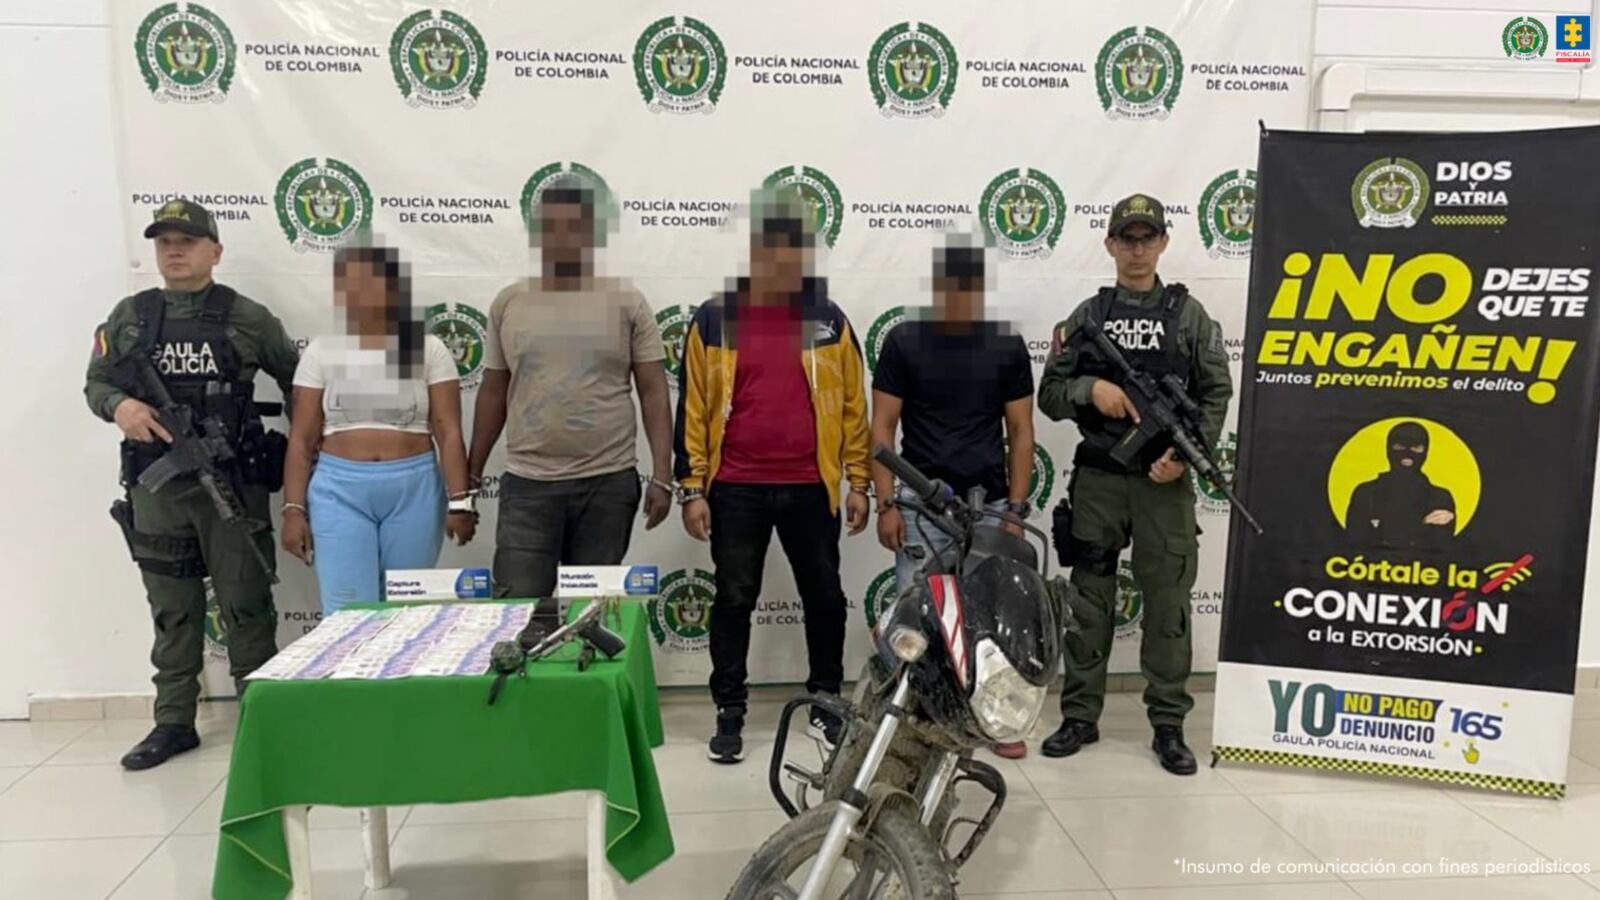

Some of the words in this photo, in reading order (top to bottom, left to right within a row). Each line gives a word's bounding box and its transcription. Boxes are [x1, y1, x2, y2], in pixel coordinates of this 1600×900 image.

[245, 43, 300, 55] POLICÍA
[305, 45, 380, 58] NACIONAL
[496, 50, 550, 62] POLICÍA
[554, 52, 626, 64] NACIONAL
[265, 61, 283, 71] DE
[287, 61, 362, 72] COLOMBIA
[735, 55, 787, 67] POLICÍA
[791, 57, 860, 69] NACIONAL
[966, 59, 1015, 72] POLICÍA
[1019, 62, 1086, 73] NACIONAL
[1191, 62, 1237, 75] POLICÍA
[1242, 65, 1306, 76] NACIONAL
[515, 67, 532, 77] DE
[536, 68, 609, 78] COLOMBIA
[753, 72, 770, 83] DE
[773, 73, 842, 84] COLOMBIA
[982, 77, 998, 87] DE
[1002, 77, 1069, 88] COLOMBIA
[1206, 79, 1221, 90] DE
[1225, 80, 1289, 91] COLOMBIA
[1436, 161, 1512, 182] DIOS
[1468, 182, 1479, 190] Y
[193, 194, 267, 206] NACIONAL
[380, 196, 436, 209] POLICÍA
[439, 198, 510, 210] NACIONAL
[623, 198, 675, 211] POLICÍA
[1434, 191, 1509, 206] PATRIA
[852, 201, 902, 213] POLICÍA
[906, 203, 972, 214] NACIONAL
[400, 213, 417, 223] DE
[421, 213, 494, 224] COLOMBIA
[641, 216, 657, 227] DE
[869, 218, 884, 228] DE
[888, 218, 955, 229] COLOMBIA
[1090, 219, 1106, 229] DE
[1482, 268, 1591, 293] DEJES
[1267, 252, 1473, 325] ¡NO
[1478, 296, 1543, 321] QUE
[1550, 296, 1589, 318] TE
[1103, 319, 1165, 336] POLICIA
[152, 342, 213, 359] GAULA
[157, 357, 219, 374] OLICIA
[1256, 370, 1313, 385] Juntos
[1314, 371, 1449, 389] prevenimos
[1452, 377, 1470, 390] el
[1473, 378, 1525, 392] delito
[1325, 555, 1440, 586] Córtale
[1448, 564, 1478, 589] la
[758, 600, 790, 612] LICÍA
[1282, 587, 1508, 634] CONEXIÓN
[284, 611, 323, 621] POLIC
[757, 616, 774, 625] DE
[1308, 628, 1321, 642] a
[1326, 626, 1345, 644] la
[1351, 630, 1473, 657] EXTORSIÓN
[1267, 679, 1337, 737] YO
[1343, 693, 1373, 714] NO
[1378, 696, 1434, 721] PAGO
[1340, 717, 1435, 744] DENUNCIO
[1449, 707, 1503, 741] 165
[1272, 733, 1315, 747] GAULA
[1317, 738, 1367, 753] POLICÍA
[1369, 744, 1435, 760] NACIONAL
